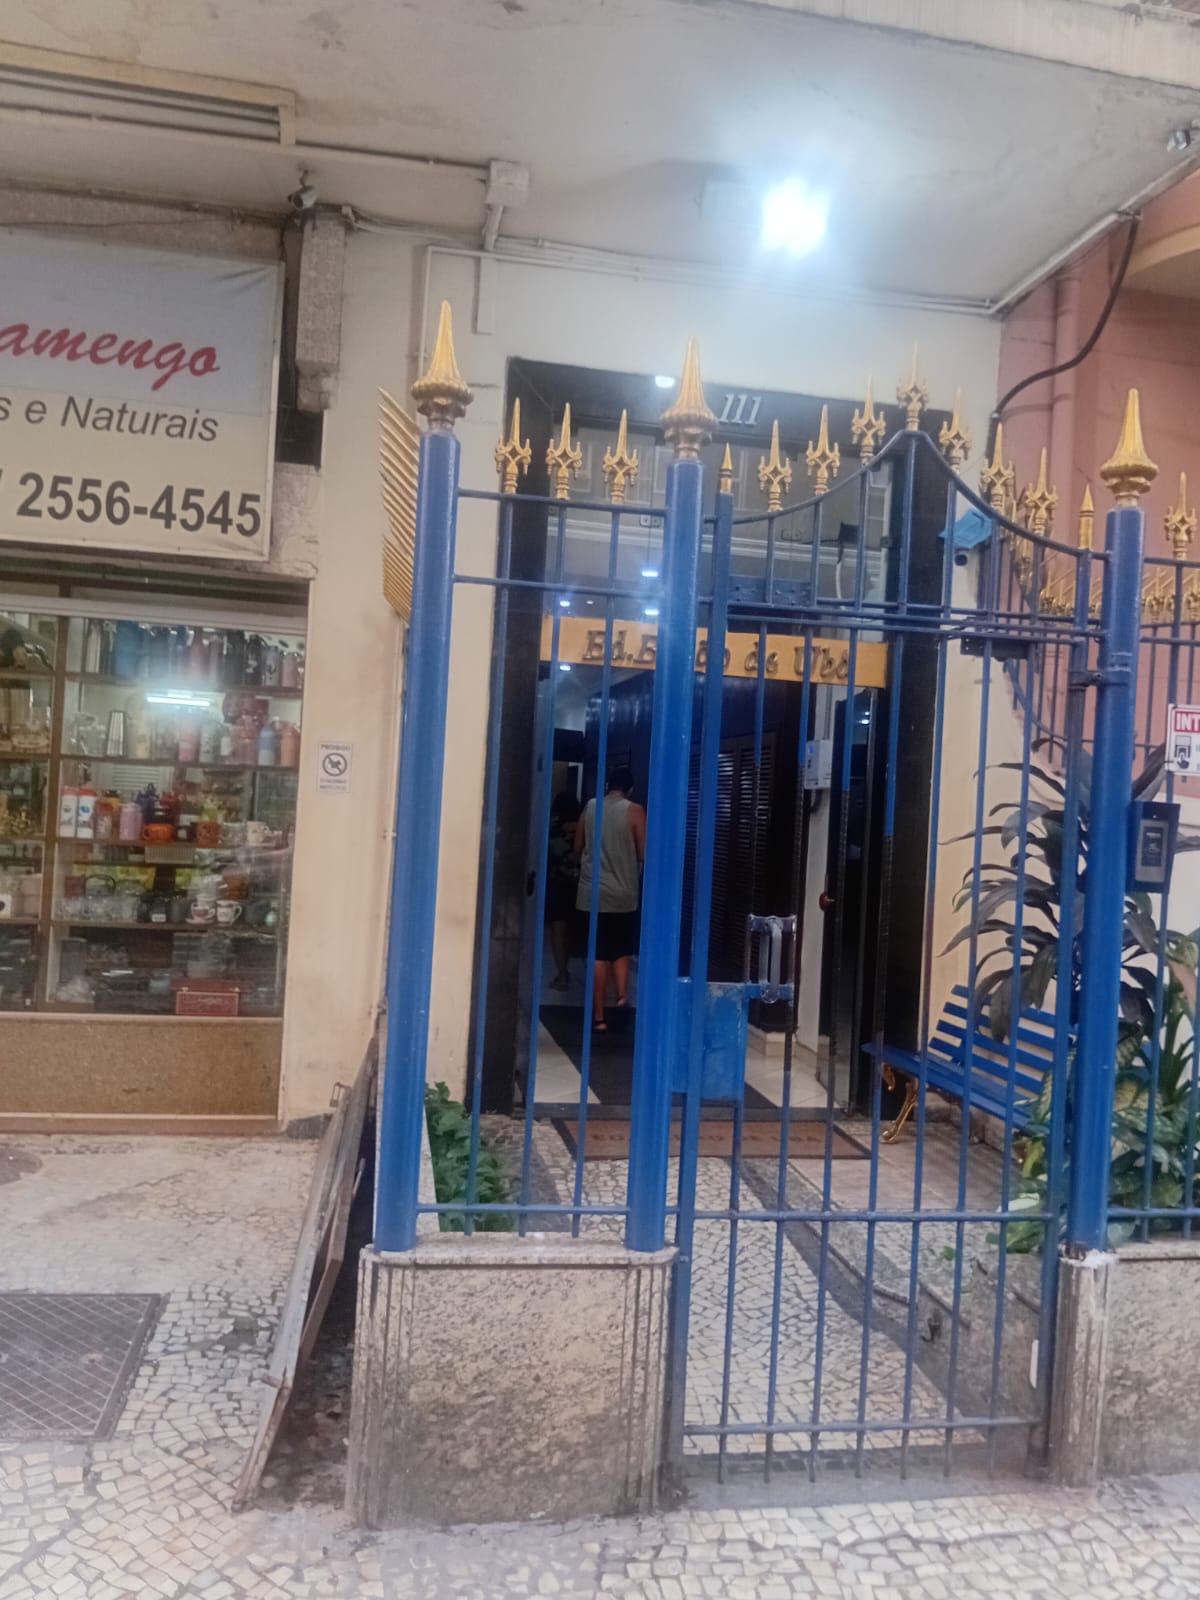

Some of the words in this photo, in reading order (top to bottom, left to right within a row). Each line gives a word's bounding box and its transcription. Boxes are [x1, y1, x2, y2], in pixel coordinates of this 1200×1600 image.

[25, 400, 47, 425] e
[60, 396, 219, 442] Naturais
[16, 471, 262, 538] 2556-4545
